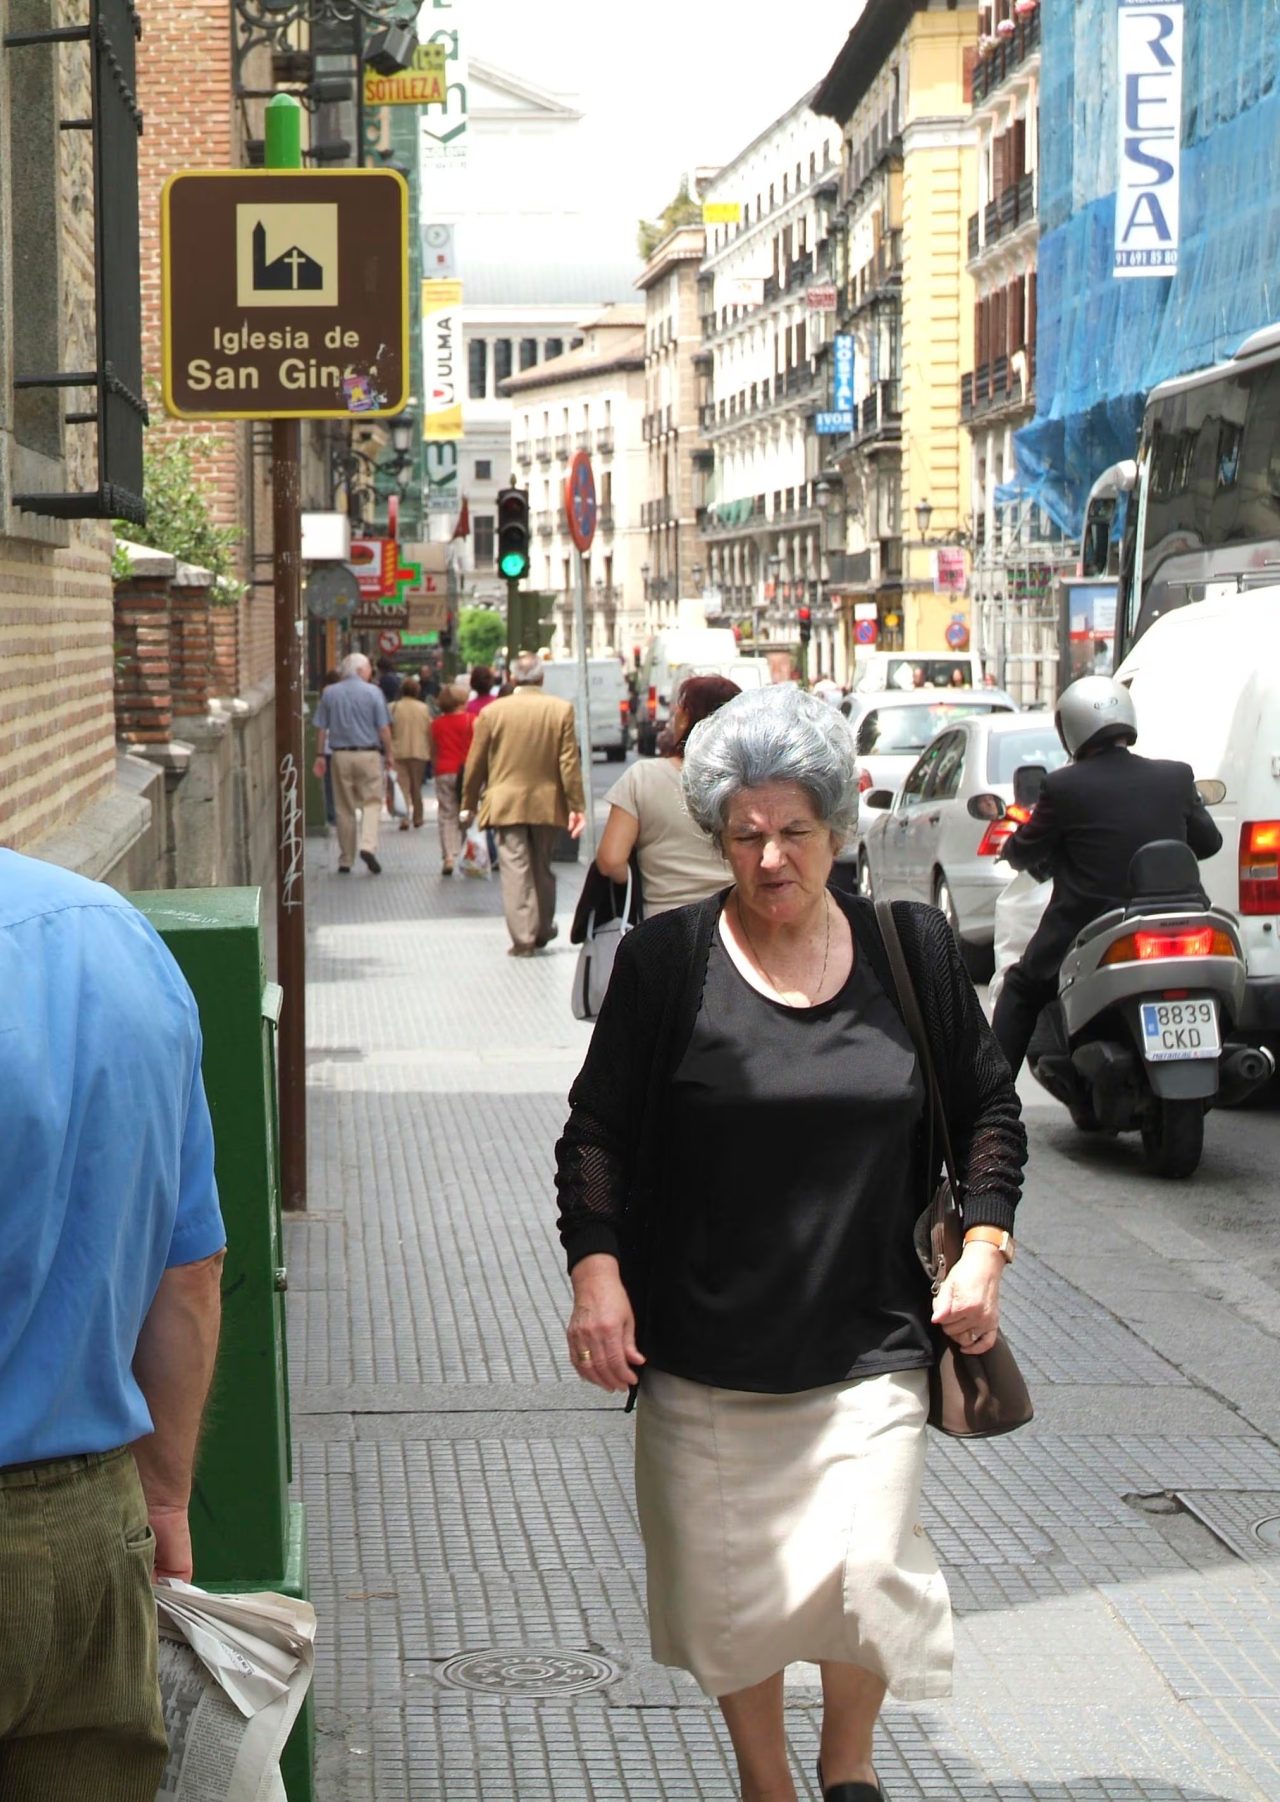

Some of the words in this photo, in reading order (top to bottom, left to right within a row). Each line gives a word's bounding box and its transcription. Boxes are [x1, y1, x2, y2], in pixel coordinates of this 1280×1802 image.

[366, 78, 440, 101] SOTILEZA
[1122, 13, 1175, 243] RESA
[1116, 252, 1127, 266] 91
[1130, 251, 1146, 265] 691
[214, 325, 309, 355] Iglesia
[325, 326, 359, 349] de
[437, 317, 452, 377] ULMA
[187, 359, 259, 390] San
[837, 336, 852, 411] HOSTAL
[1158, 1004, 1211, 1025] 8839
[1162, 1028, 1201, 1049] CKD
